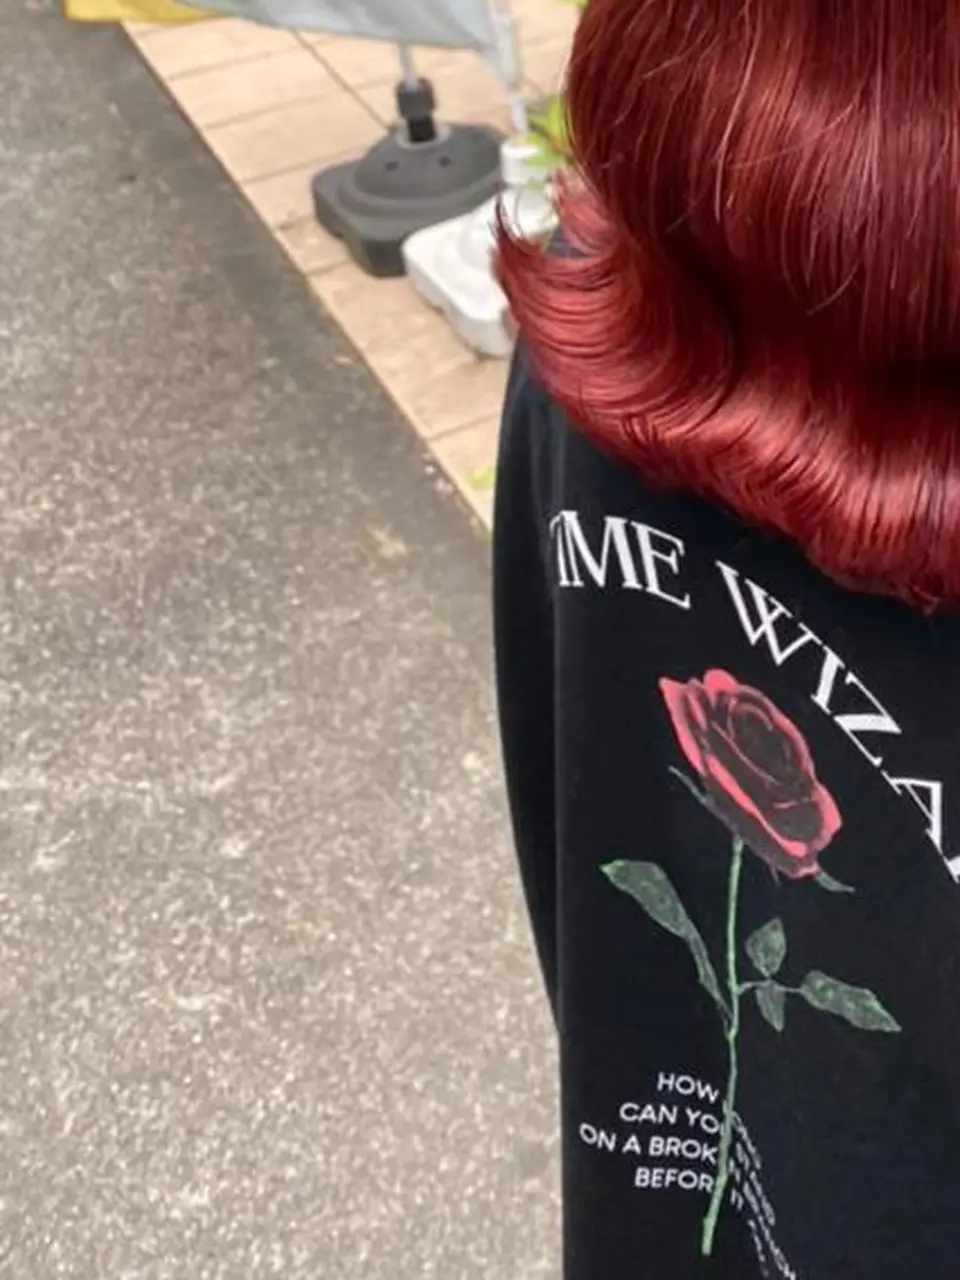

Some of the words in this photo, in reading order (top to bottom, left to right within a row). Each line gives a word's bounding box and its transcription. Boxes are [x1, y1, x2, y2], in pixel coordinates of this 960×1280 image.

[657, 1072, 719, 1103] HOW
[619, 1102, 678, 1125] CAN
[685, 1107, 723, 1135] YO
[578, 1123, 616, 1153] ON
[622, 1135, 642, 1155] A
[649, 1136, 718, 1165] BROK
[634, 1167, 715, 1193] BEFOR
